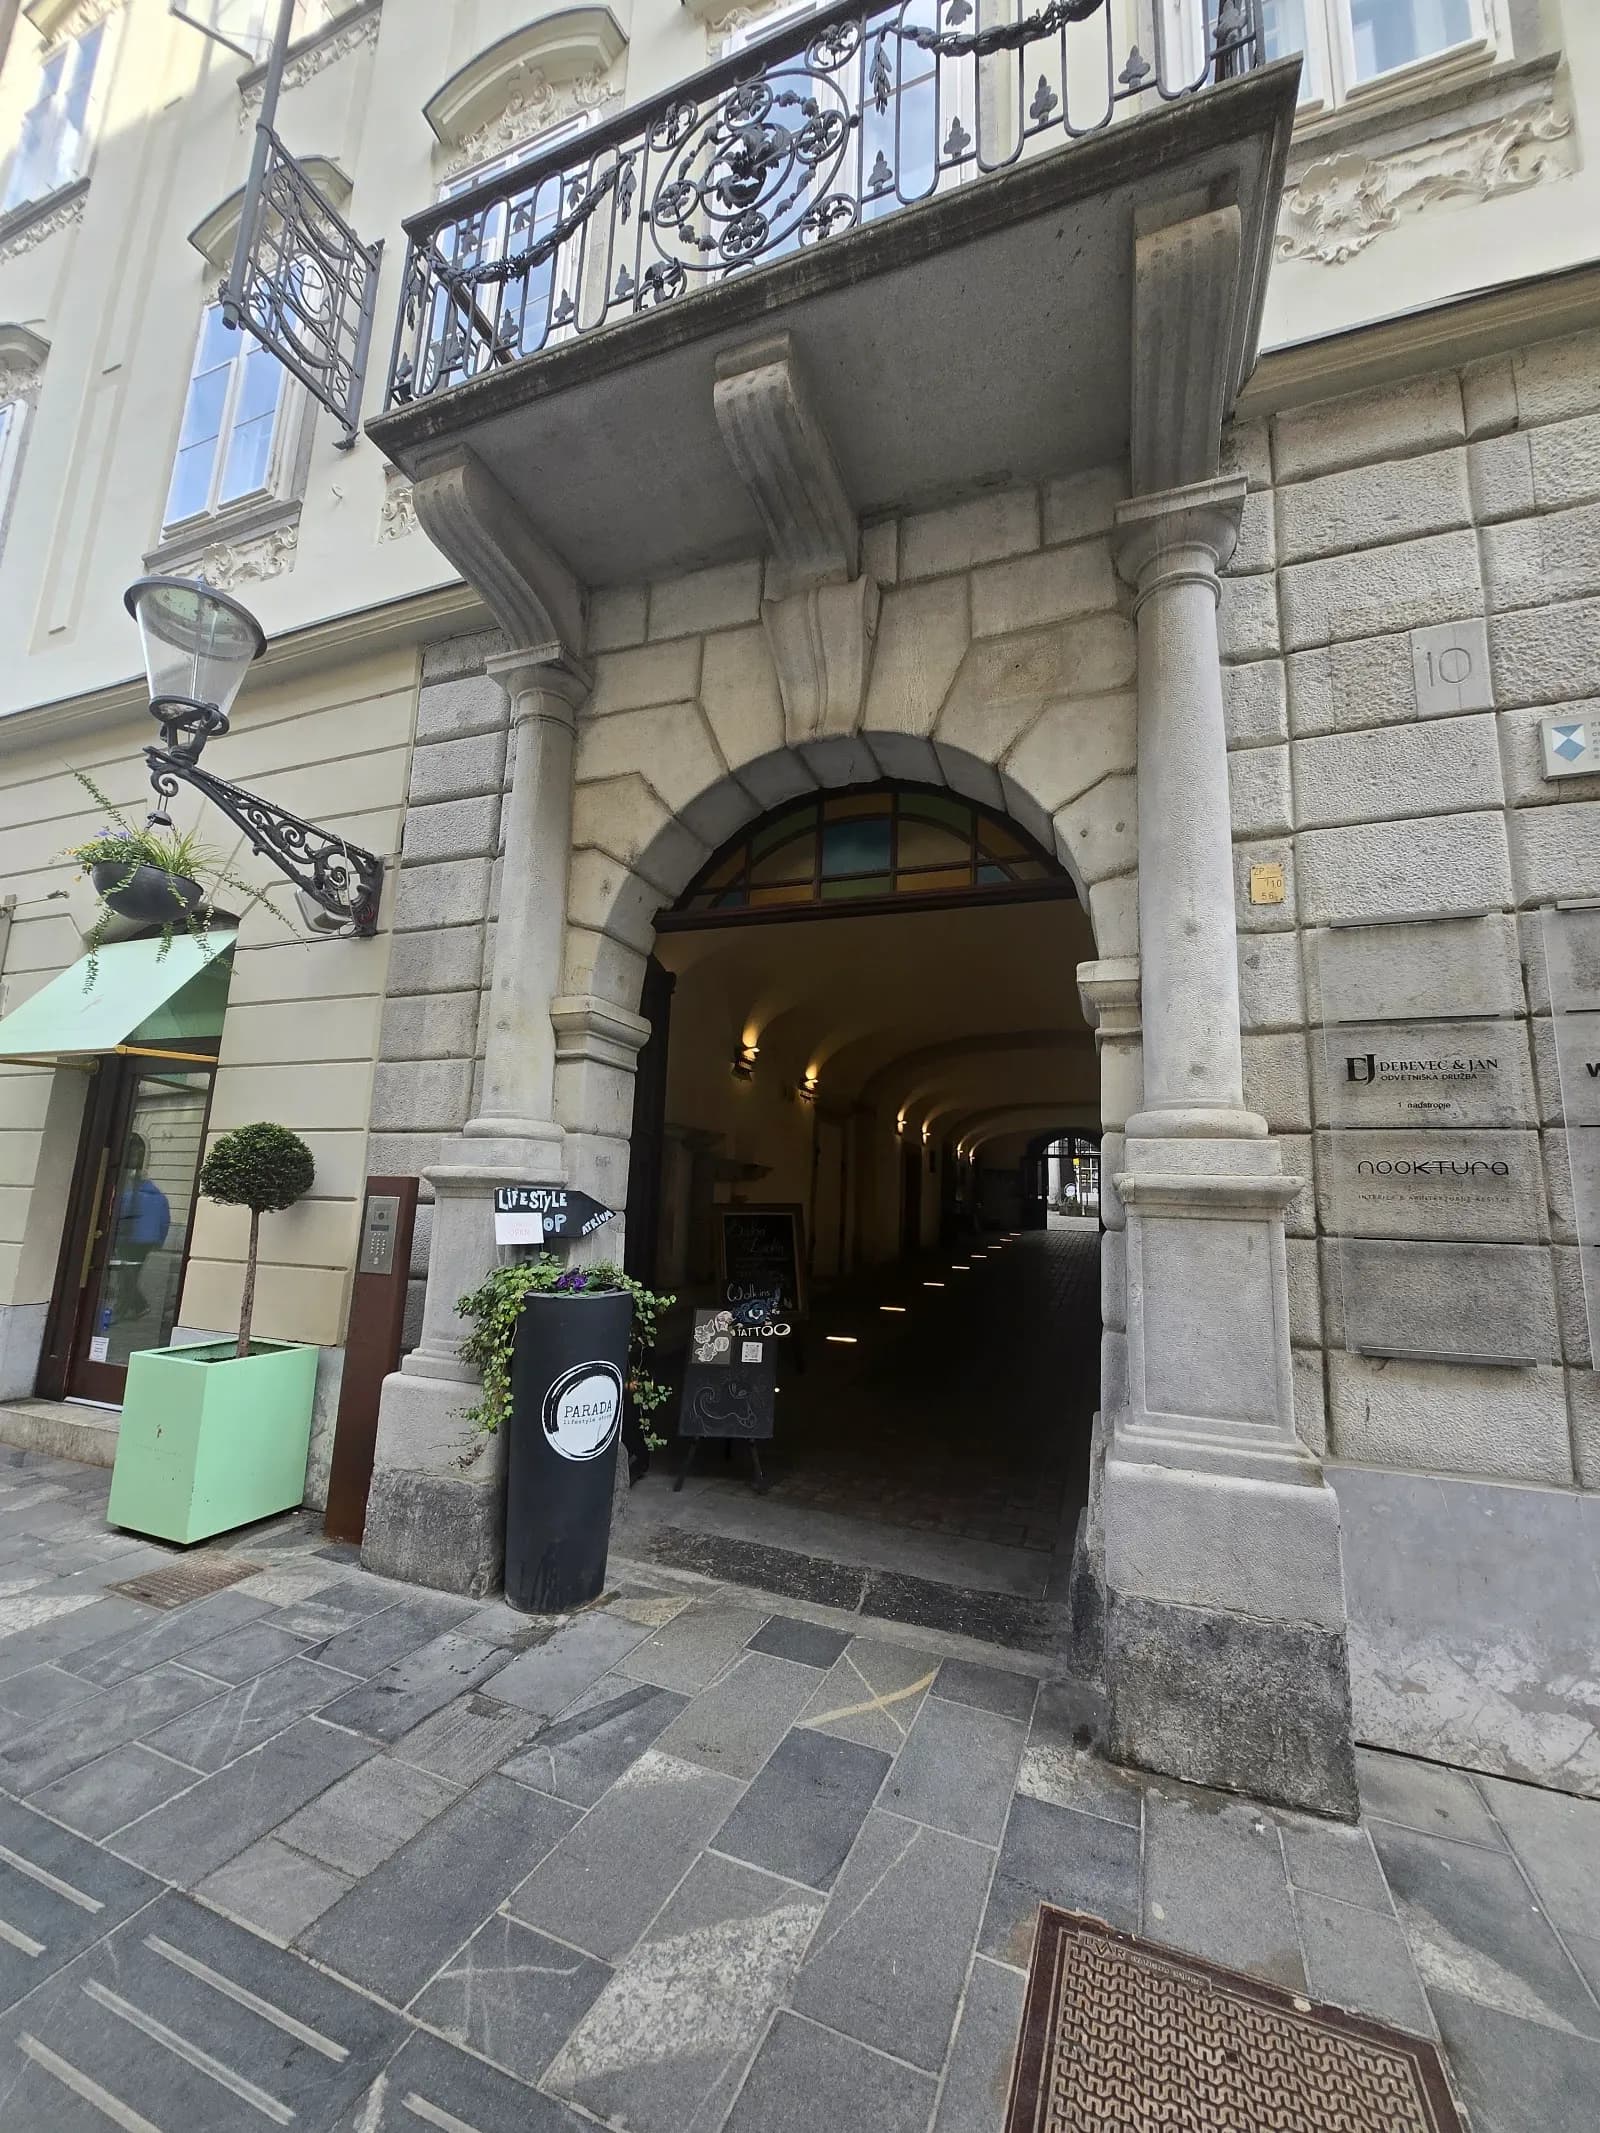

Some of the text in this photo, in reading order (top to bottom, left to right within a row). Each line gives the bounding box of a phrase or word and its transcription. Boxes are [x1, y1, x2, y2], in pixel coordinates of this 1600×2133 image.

[1427, 647, 1472, 687] 10
[1380, 1059, 1498, 1072] DEBEVEC & JAN
[738, 1323, 791, 1337] TATTOO
[564, 1399, 612, 1418] PARADA
